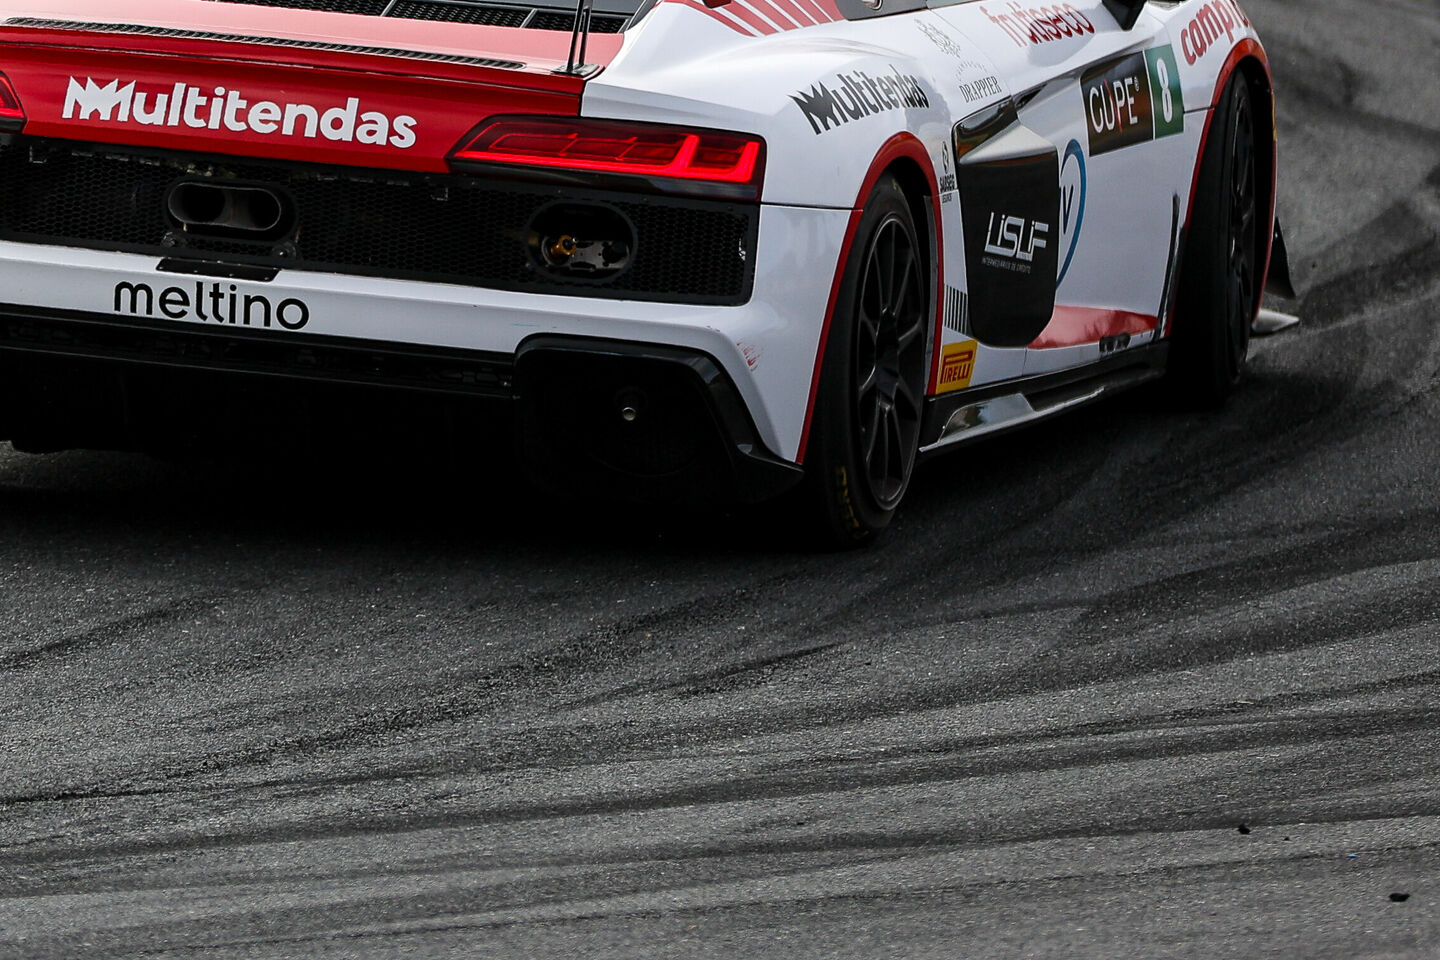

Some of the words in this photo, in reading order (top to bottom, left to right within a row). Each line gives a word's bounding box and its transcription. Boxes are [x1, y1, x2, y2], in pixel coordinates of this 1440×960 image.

[62, 76, 417, 150] Multitendas
[787, 63, 930, 135] Multitendas
[959, 75, 1002, 103] DRAPPIER
[1156, 57, 1173, 123] 8
[114, 281, 310, 330] meltino
[940, 350, 973, 385] PIRELLI
